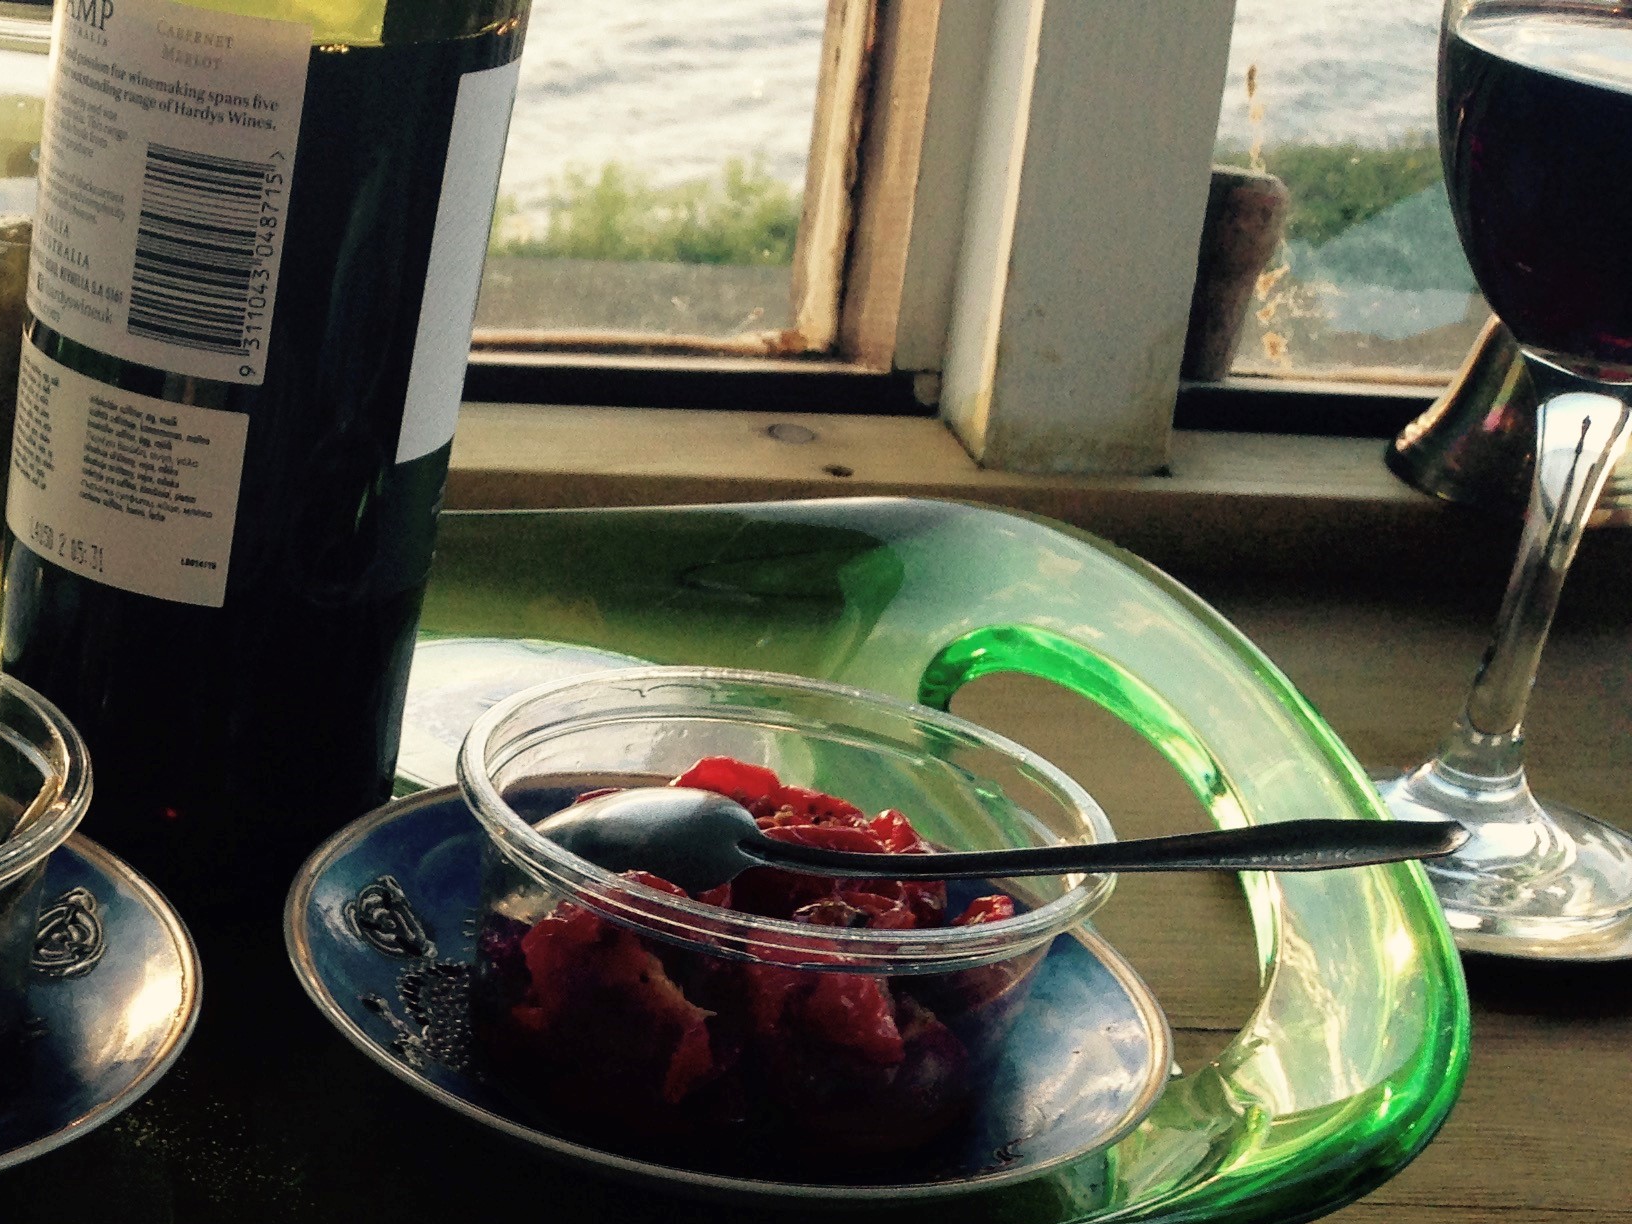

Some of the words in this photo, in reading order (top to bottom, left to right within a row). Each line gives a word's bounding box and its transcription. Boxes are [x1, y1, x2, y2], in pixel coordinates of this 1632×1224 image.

[128, 70, 206, 104] winemaking
[208, 91, 249, 108] spans
[252, 93, 279, 112] five
[158, 99, 175, 112] of
[175, 102, 225, 126] Hardys
[255, 172, 284, 259] 048715
[243, 268, 270, 350] 311043
